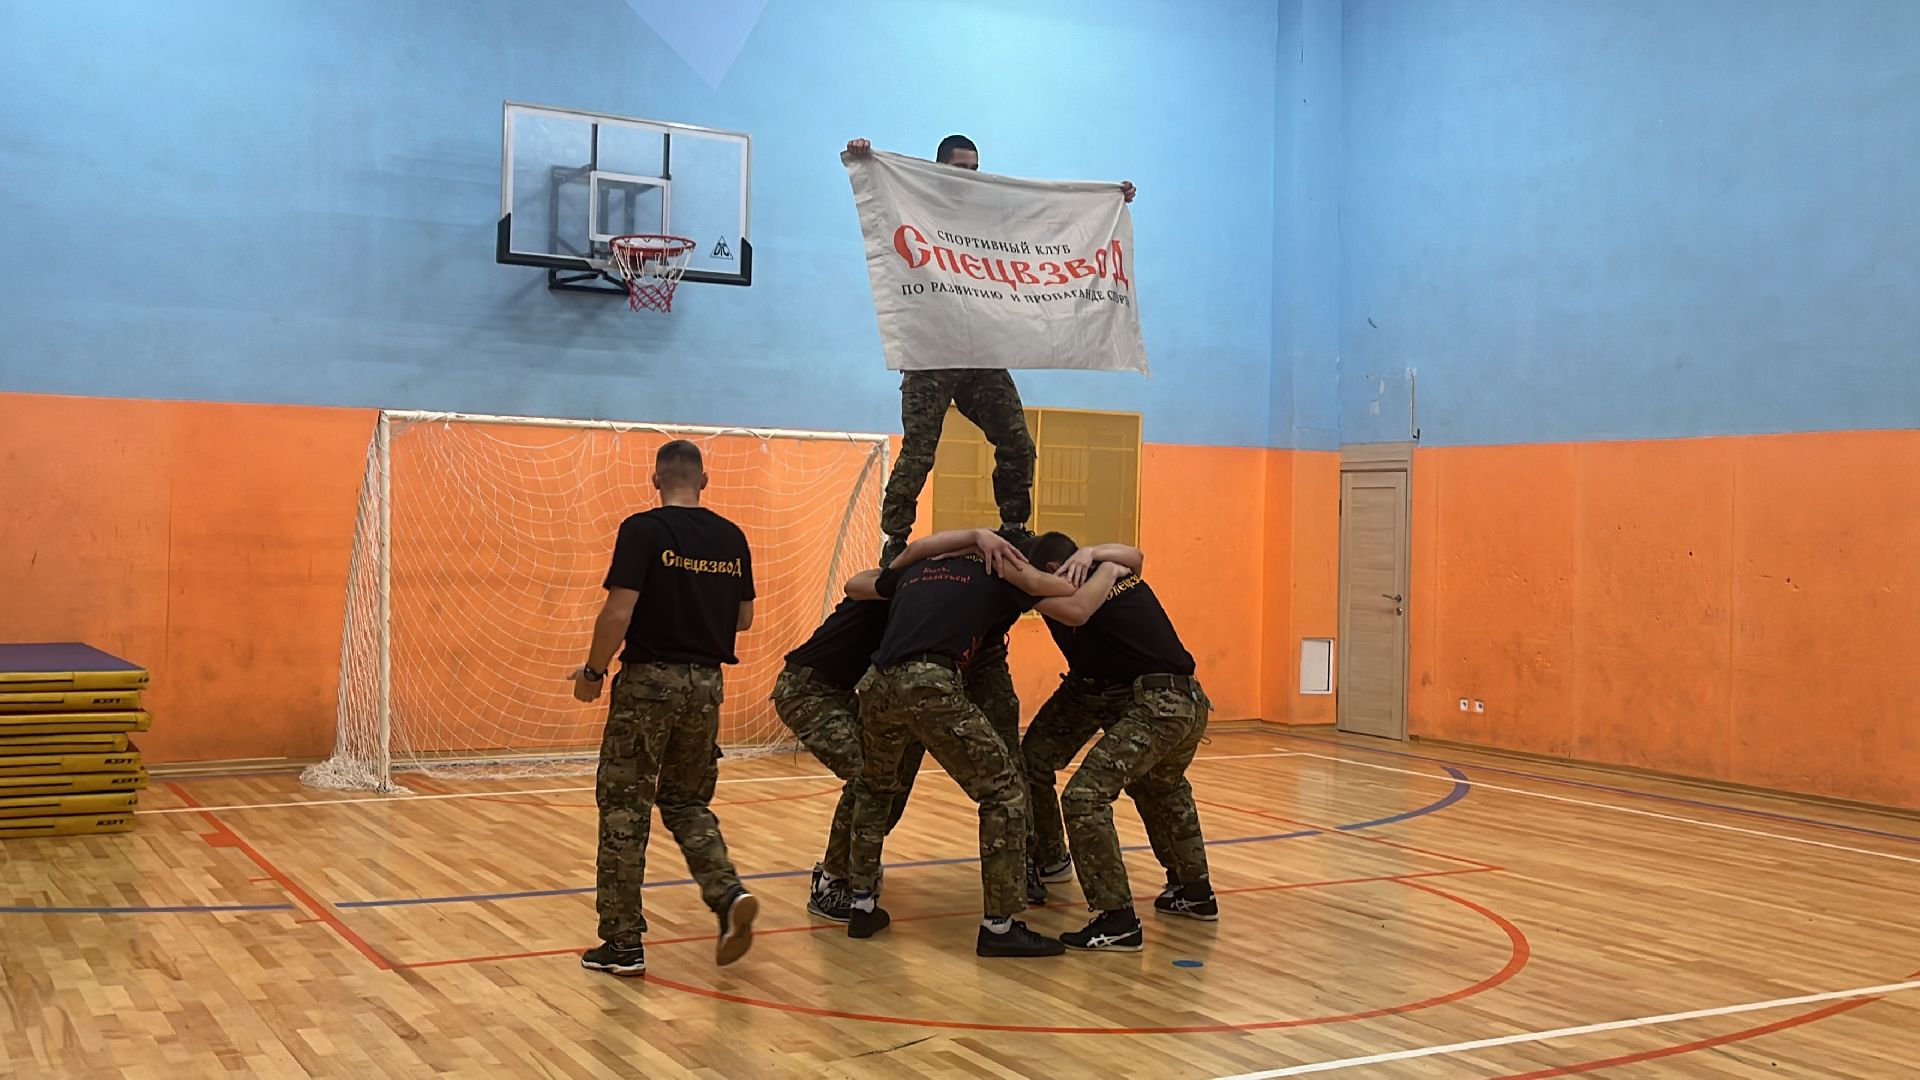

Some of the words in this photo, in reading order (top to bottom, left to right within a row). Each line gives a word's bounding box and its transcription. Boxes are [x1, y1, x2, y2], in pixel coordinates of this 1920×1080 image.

[937, 229, 1030, 255] СПОРТИВНЫЙ
[1035, 244, 1071, 255] КЛУБ
[901, 283, 924, 295] ПО
[930, 282, 1003, 300] РАЗВИТИЮ
[1010, 293, 1021, 302] И
[1024, 288, 1105, 304] ПРОПАГАНДЕ
